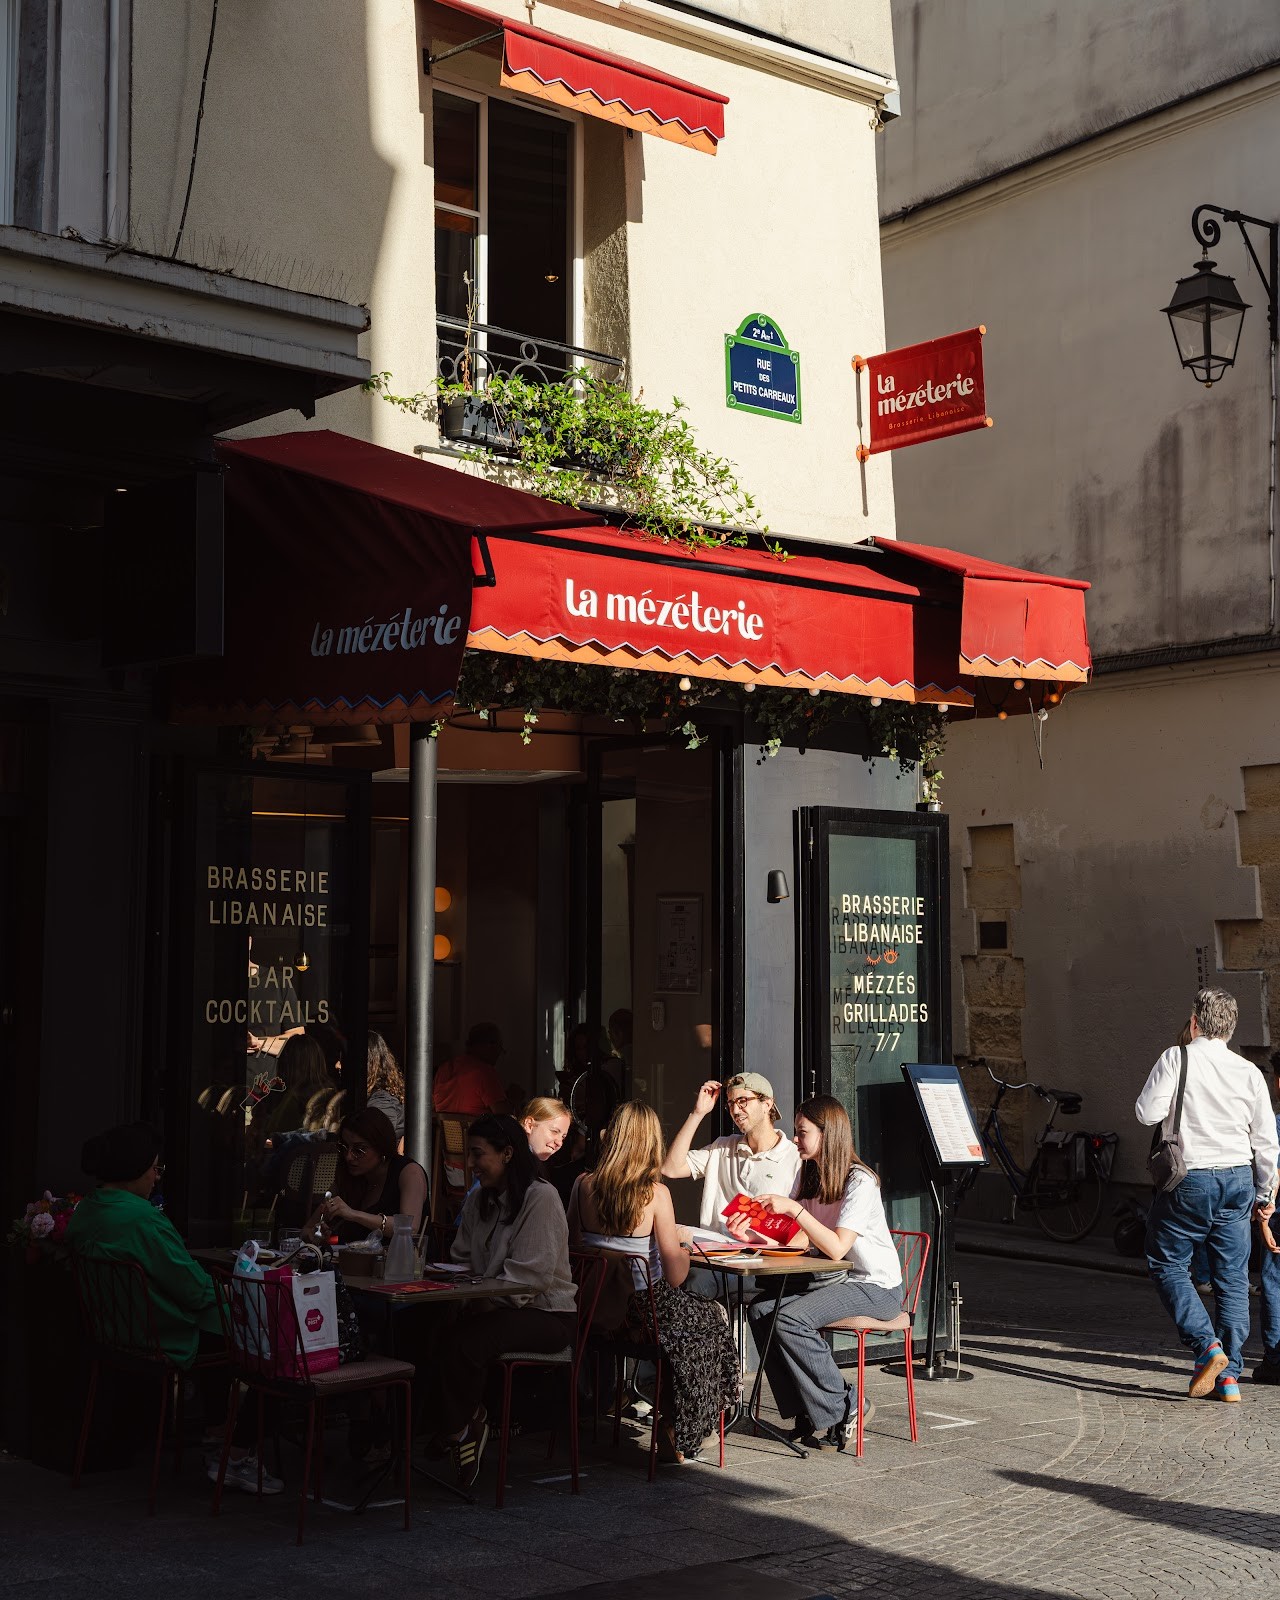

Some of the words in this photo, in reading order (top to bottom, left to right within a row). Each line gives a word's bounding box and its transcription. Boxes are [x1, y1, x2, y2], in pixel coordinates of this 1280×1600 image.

[756, 358, 772, 371] RUE
[758, 373, 770, 383] DES
[877, 374, 895, 395] la
[733, 381, 757, 396] PETITS
[758, 386, 796, 405] CARREAUX
[878, 373, 974, 417] mézéterie
[888, 417, 924, 430] Brasserie
[928, 406, 965, 420] Libanaise
[566, 578, 599, 618] la
[606, 589, 764, 641] mézéterie
[310, 621, 334, 657] la
[336, 603, 462, 655] mézéterie
[207, 865, 329, 894] BRASSERIE
[209, 900, 328, 927] LIBANAISE
[842, 894, 925, 916] BRASSERIE
[844, 922, 924, 944] LIBANAISE
[248, 966, 294, 989] BAR
[854, 971, 916, 994] MÉZZÉS
[205, 999, 330, 1024] COCKTAILS
[843, 1002, 929, 1023] GRILLADES
[875, 1033, 901, 1052] 7/7
